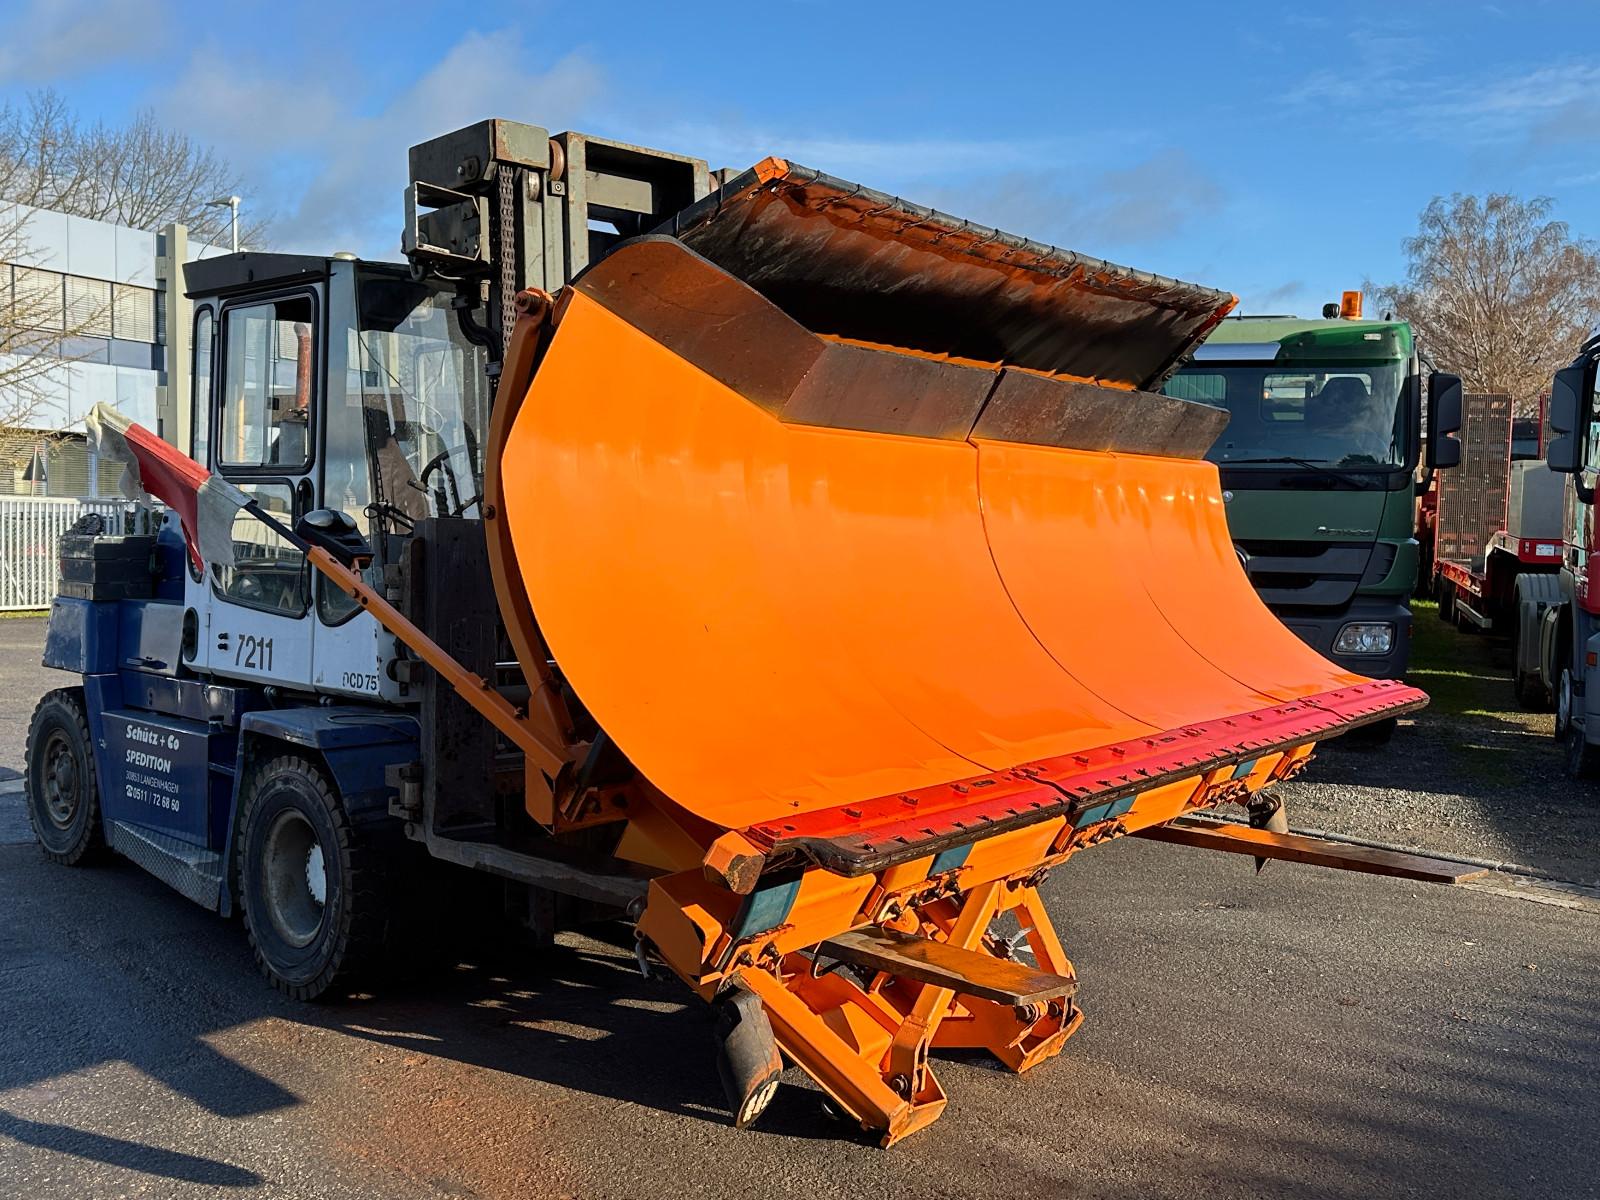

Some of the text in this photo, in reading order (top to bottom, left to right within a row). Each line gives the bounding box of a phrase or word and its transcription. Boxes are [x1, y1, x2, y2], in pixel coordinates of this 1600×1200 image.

[235, 634, 272, 671] 7211
[126, 724, 180, 750] Schütz + Co
[126, 750, 171, 773] SPEDITION
[140, 774, 179, 793] LANGENHAGEN
[153, 793, 160, 806] 72
[162, 796, 170, 809] 68
[171, 799, 180, 812] 60
